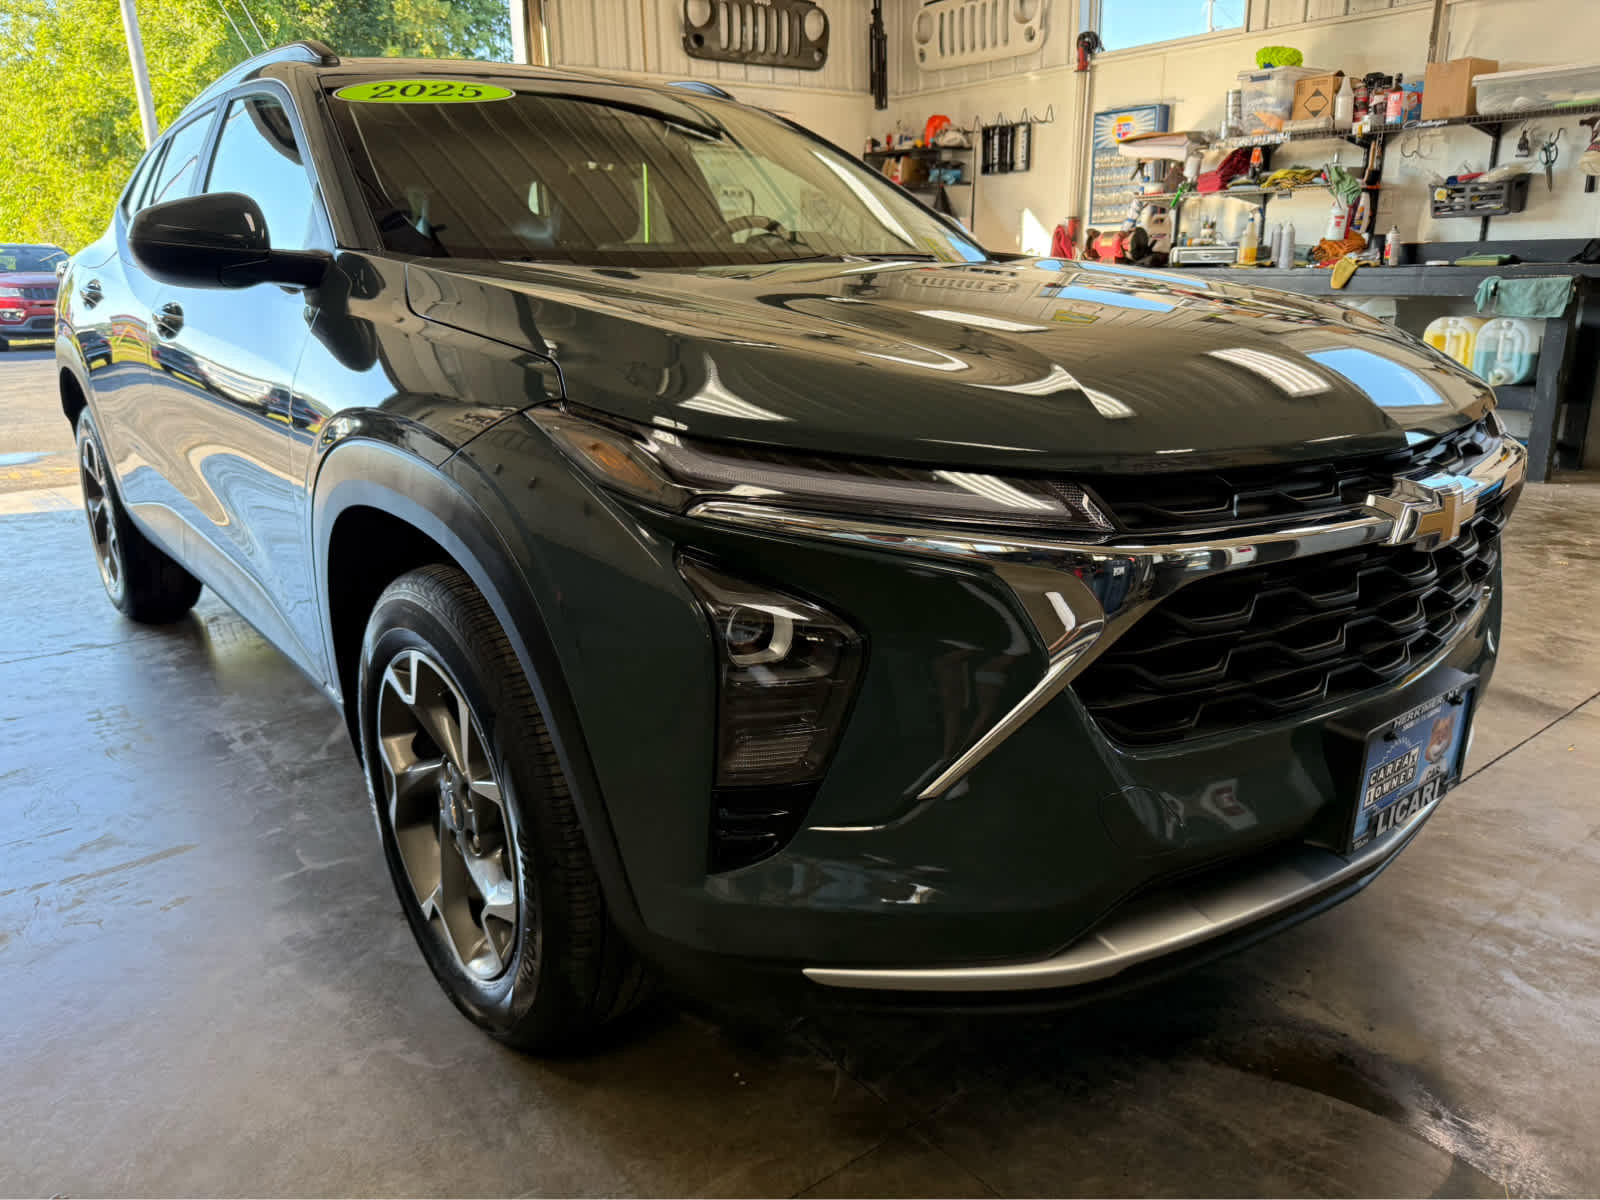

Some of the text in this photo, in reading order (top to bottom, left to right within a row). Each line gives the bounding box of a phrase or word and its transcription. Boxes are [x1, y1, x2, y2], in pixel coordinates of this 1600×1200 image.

[368, 84, 483, 99] 2025
[1370, 747, 1420, 785] CARFAX
[1375, 768, 1414, 798] OWNER
[1376, 777, 1440, 838] LICARI
